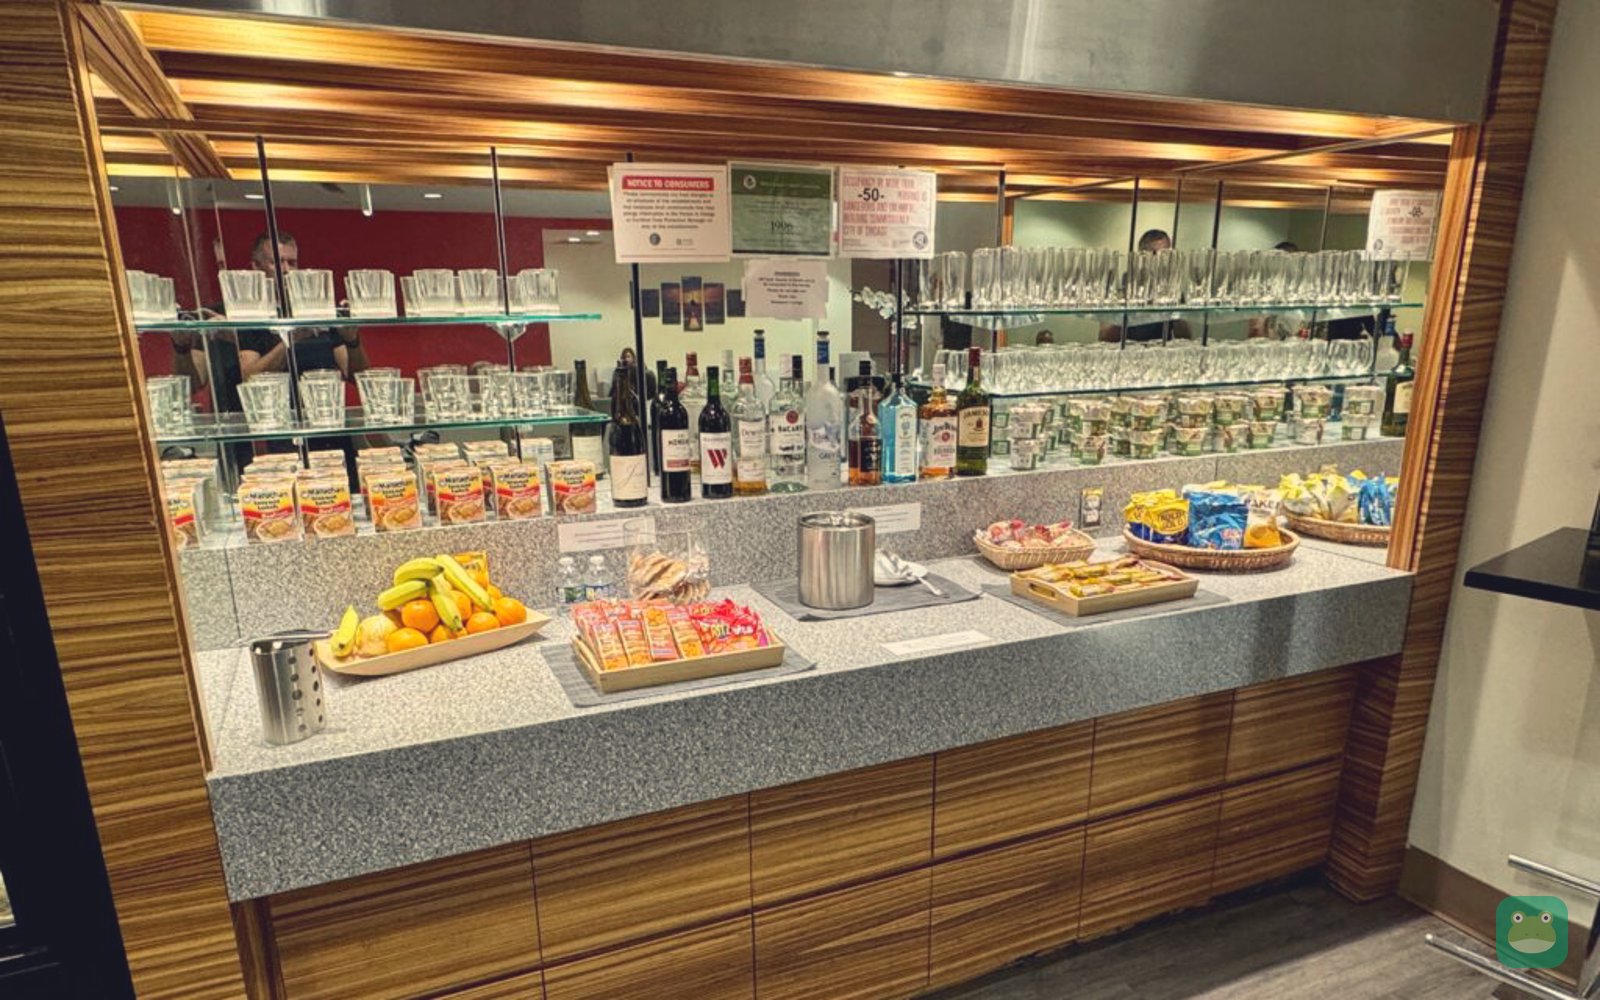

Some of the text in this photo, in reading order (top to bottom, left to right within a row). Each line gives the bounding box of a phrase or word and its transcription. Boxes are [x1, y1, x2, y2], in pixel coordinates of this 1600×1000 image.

[626, 178, 710, 189] NOTICE TO CONSUMERS
